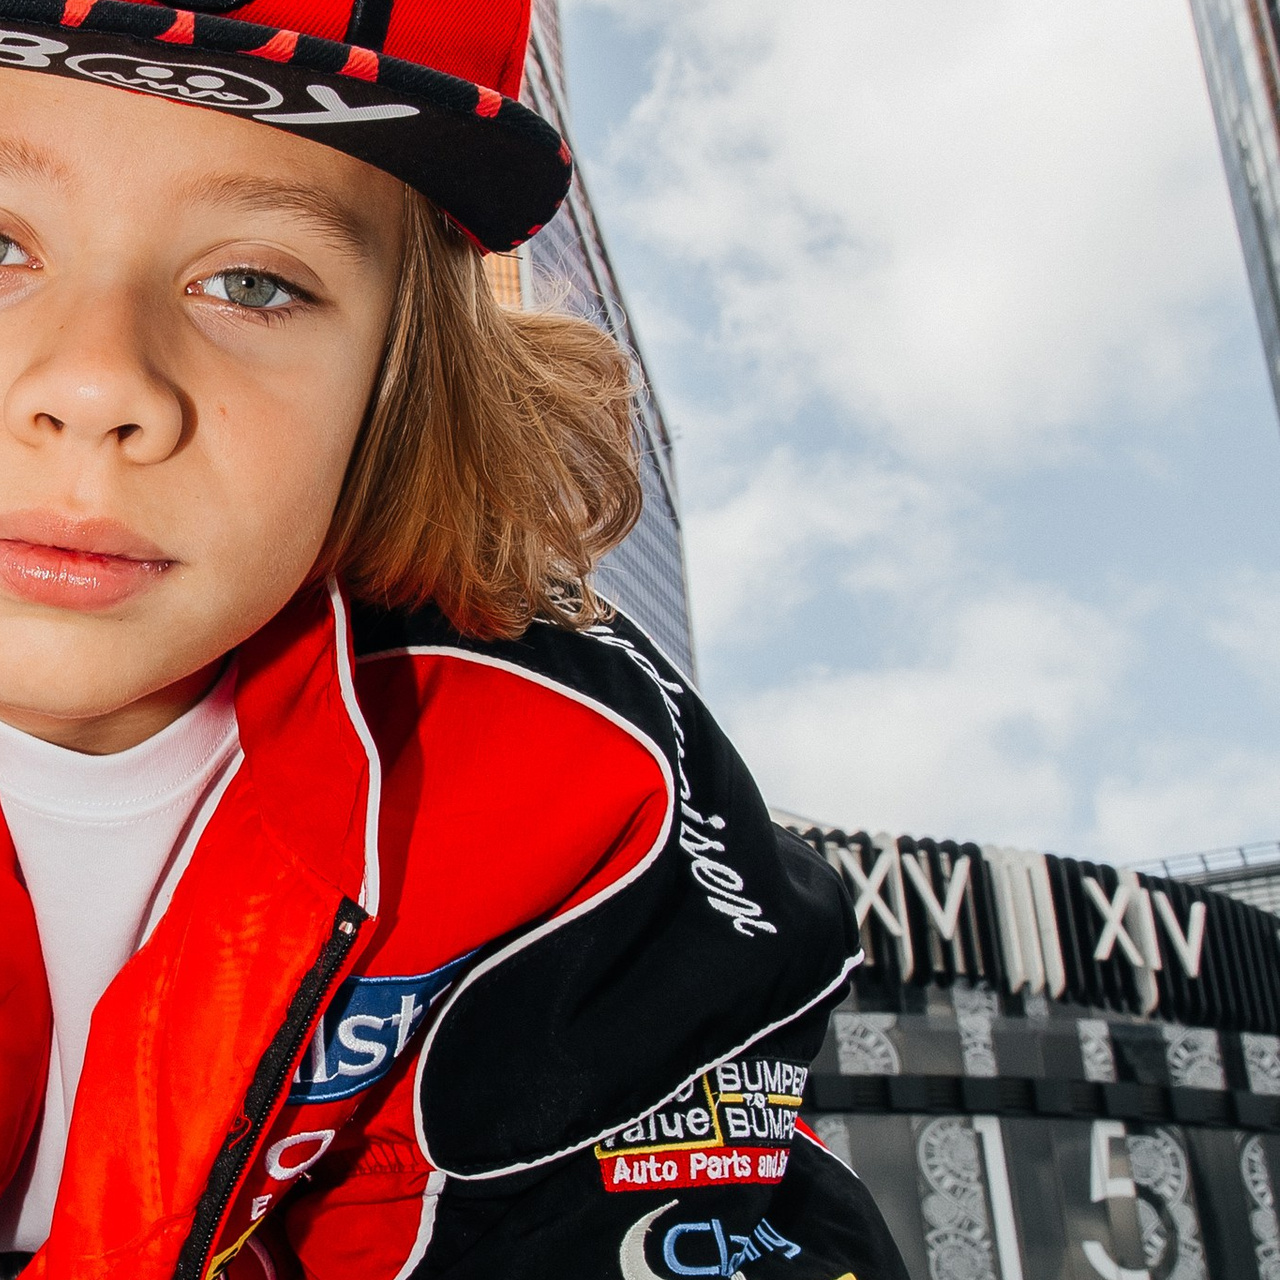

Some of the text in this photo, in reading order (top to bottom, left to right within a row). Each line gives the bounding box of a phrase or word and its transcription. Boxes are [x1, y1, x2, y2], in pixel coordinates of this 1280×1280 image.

[1081, 876, 1207, 979] XIV
[603, 1106, 710, 1148] alue
[724, 1106, 798, 1140] BUMPE
[613, 1156, 678, 1185] Auto
[689, 1150, 752, 1180] Parts
